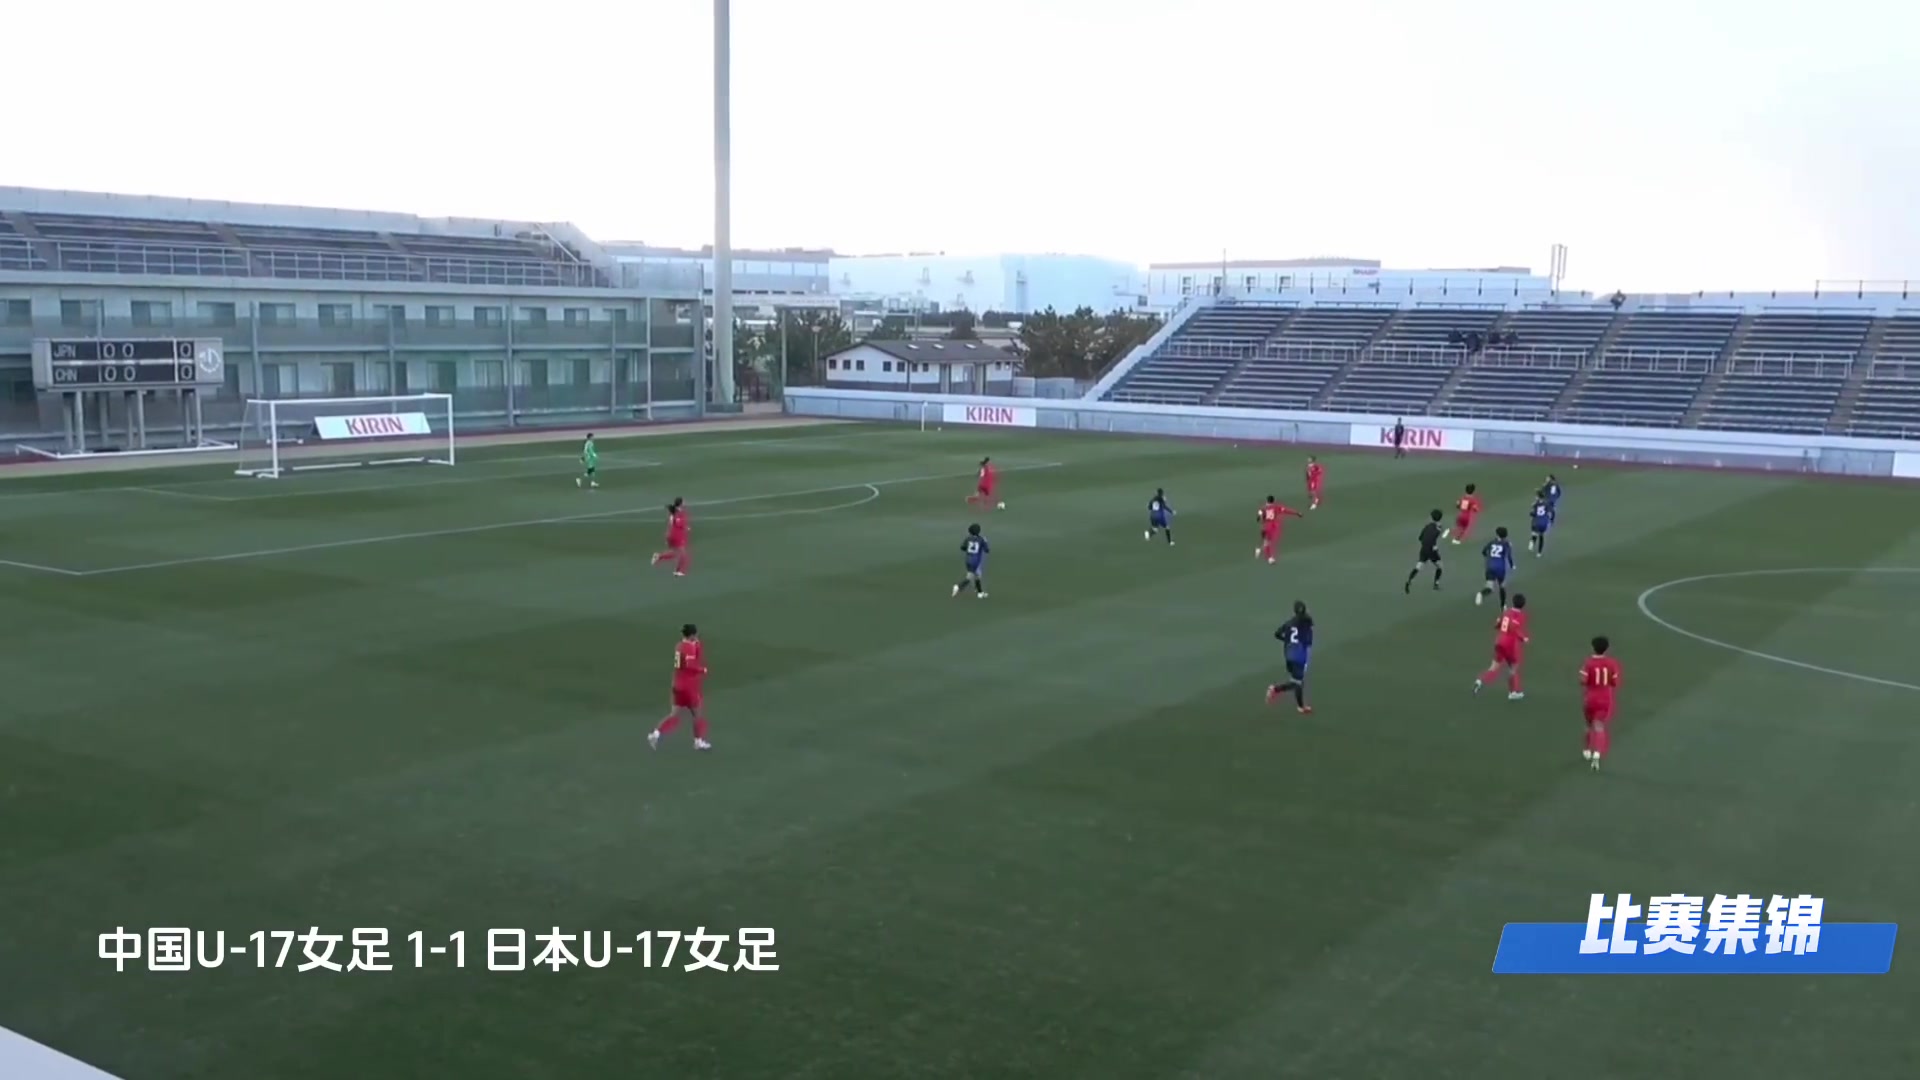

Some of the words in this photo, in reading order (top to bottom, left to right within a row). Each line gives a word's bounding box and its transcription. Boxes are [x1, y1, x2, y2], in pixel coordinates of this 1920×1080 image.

[966, 406, 1013, 423] KIRIN
[345, 416, 404, 435] KIRIN
[1380, 427, 1443, 447] KRIN
[967, 541, 980, 554] 23
[1490, 544, 1503, 558] 22
[1290, 626, 1299, 643] 2
[1595, 667, 1608, 685] 11
